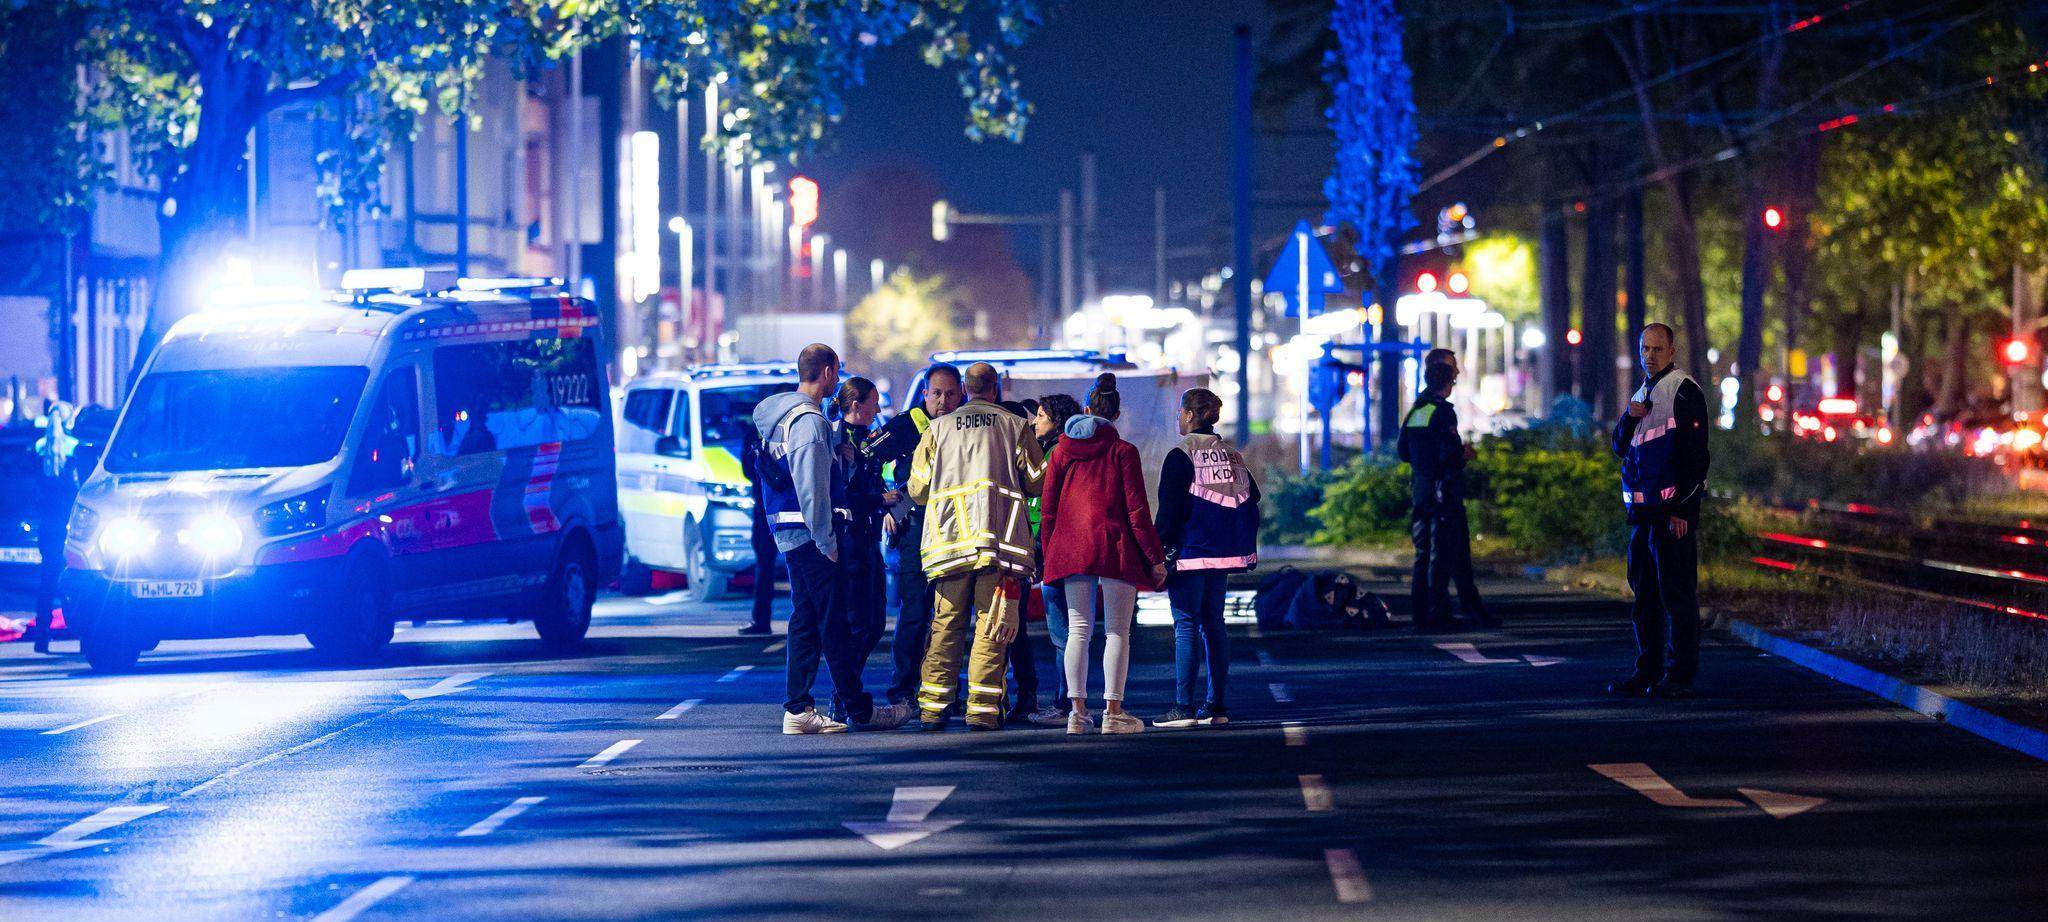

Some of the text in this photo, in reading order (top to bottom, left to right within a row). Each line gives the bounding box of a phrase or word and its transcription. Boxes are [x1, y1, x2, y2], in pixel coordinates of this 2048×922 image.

[550, 374, 589, 404] 19222
[956, 413, 998, 431] B-DIENST
[175, 582, 197, 596] 729
